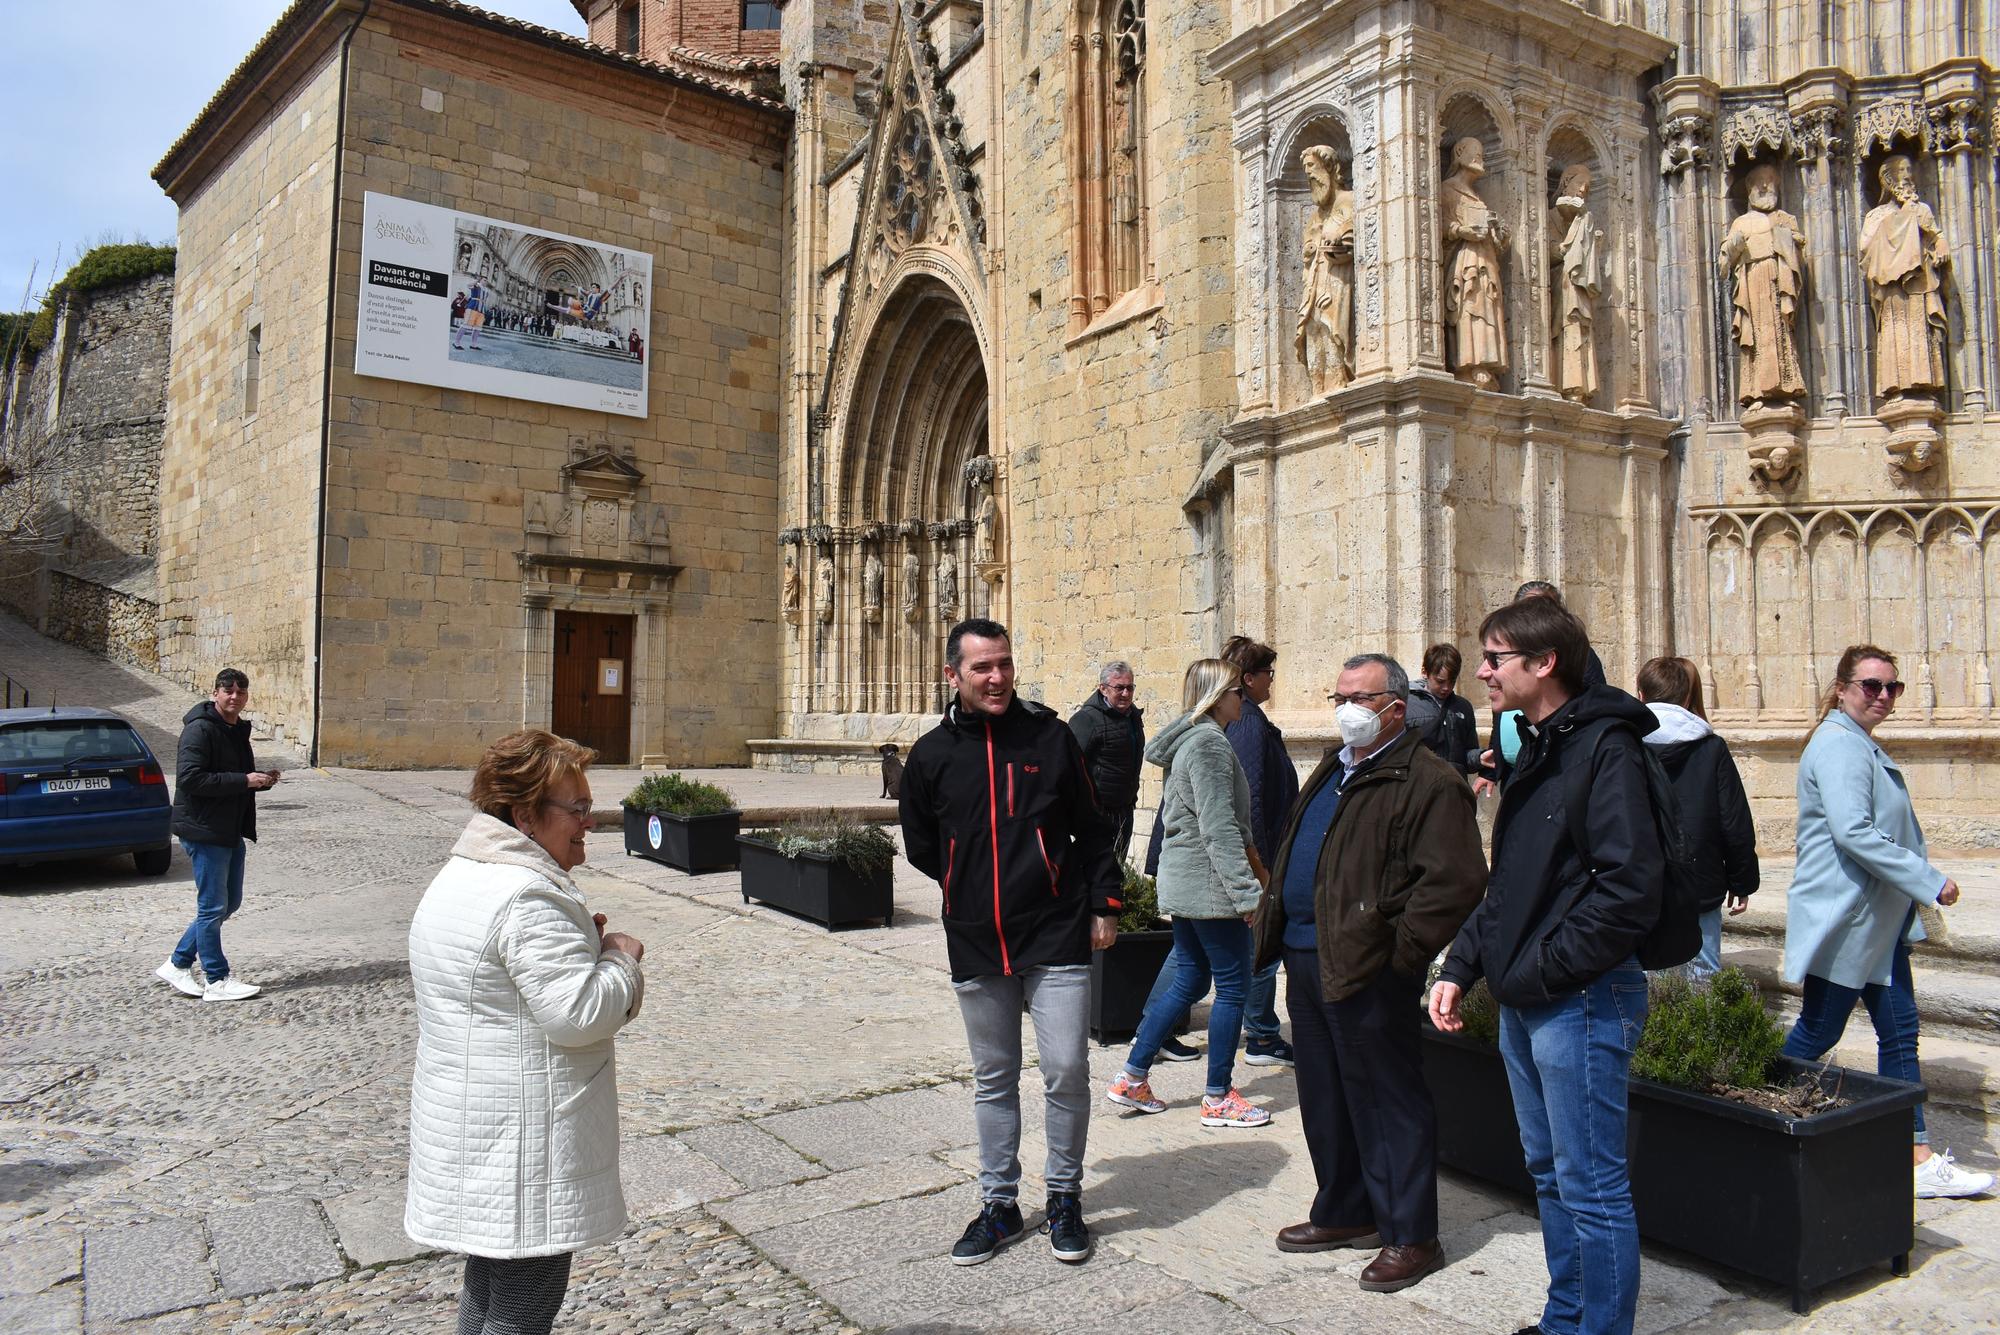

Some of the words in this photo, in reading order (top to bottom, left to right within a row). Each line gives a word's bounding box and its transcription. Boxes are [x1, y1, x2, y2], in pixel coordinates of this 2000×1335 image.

[374, 264, 407, 277] Davant
[409, 270, 421, 280] de
[422, 272, 431, 282] la
[373, 274, 427, 290] presidència
[367, 292, 385, 300] Dansa
[379, 318, 390, 326] salt
[49, 780, 81, 792] 0407
[84, 778, 108, 789] BHC
